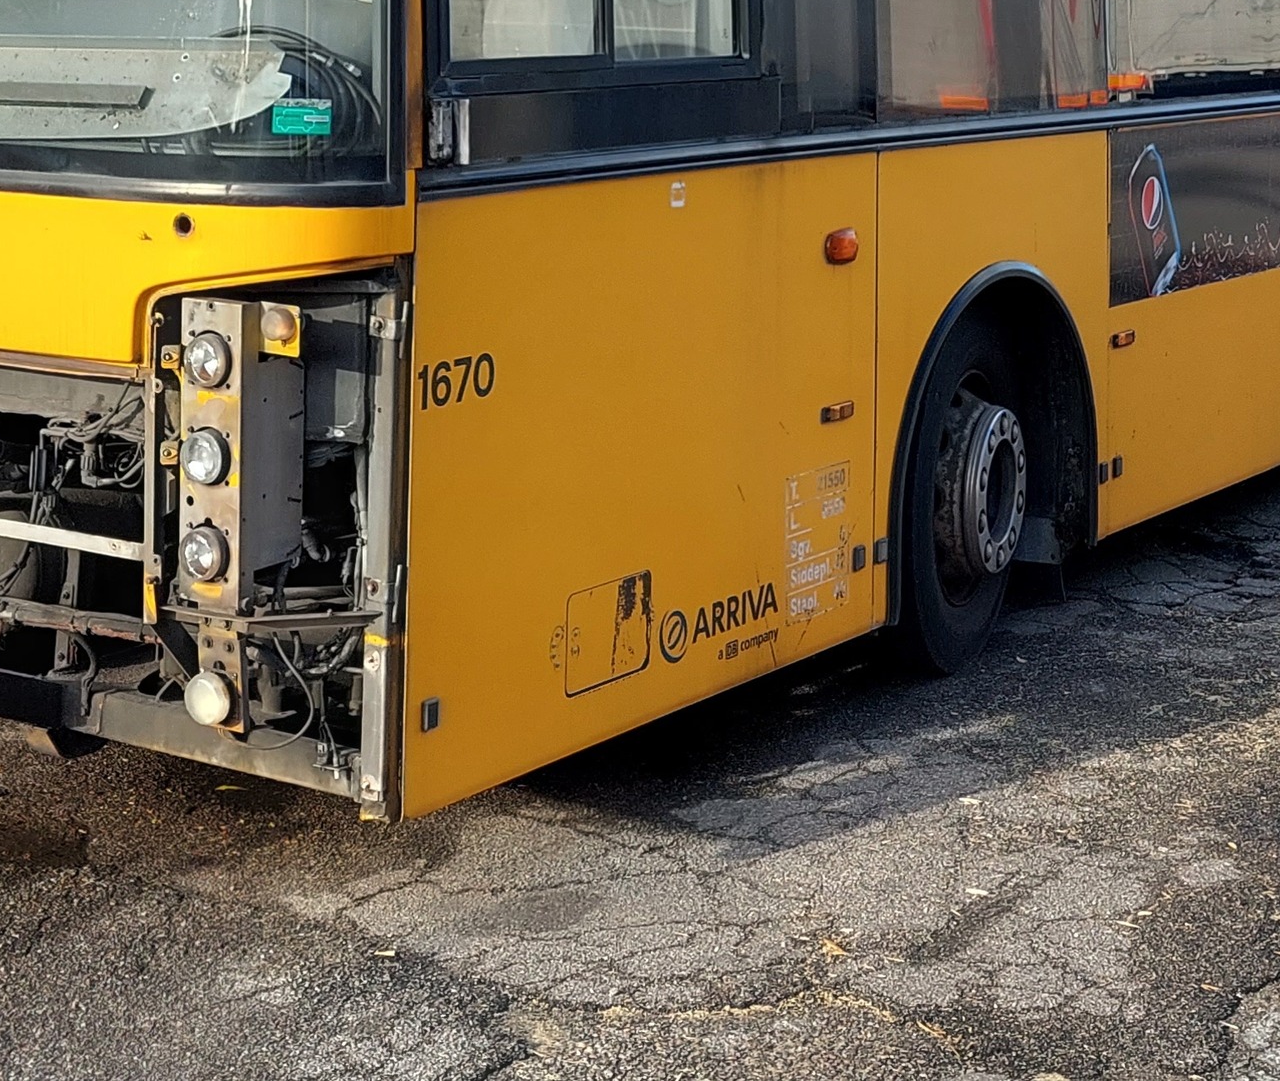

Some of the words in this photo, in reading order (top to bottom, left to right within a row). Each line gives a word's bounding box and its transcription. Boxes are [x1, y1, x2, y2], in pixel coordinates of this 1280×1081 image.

[417, 352, 495, 410] 1670
[692, 582, 778, 644] ARRIVA
[718, 649, 724, 660] a
[726, 640, 738, 659] DB
[740, 628, 779, 652] company
